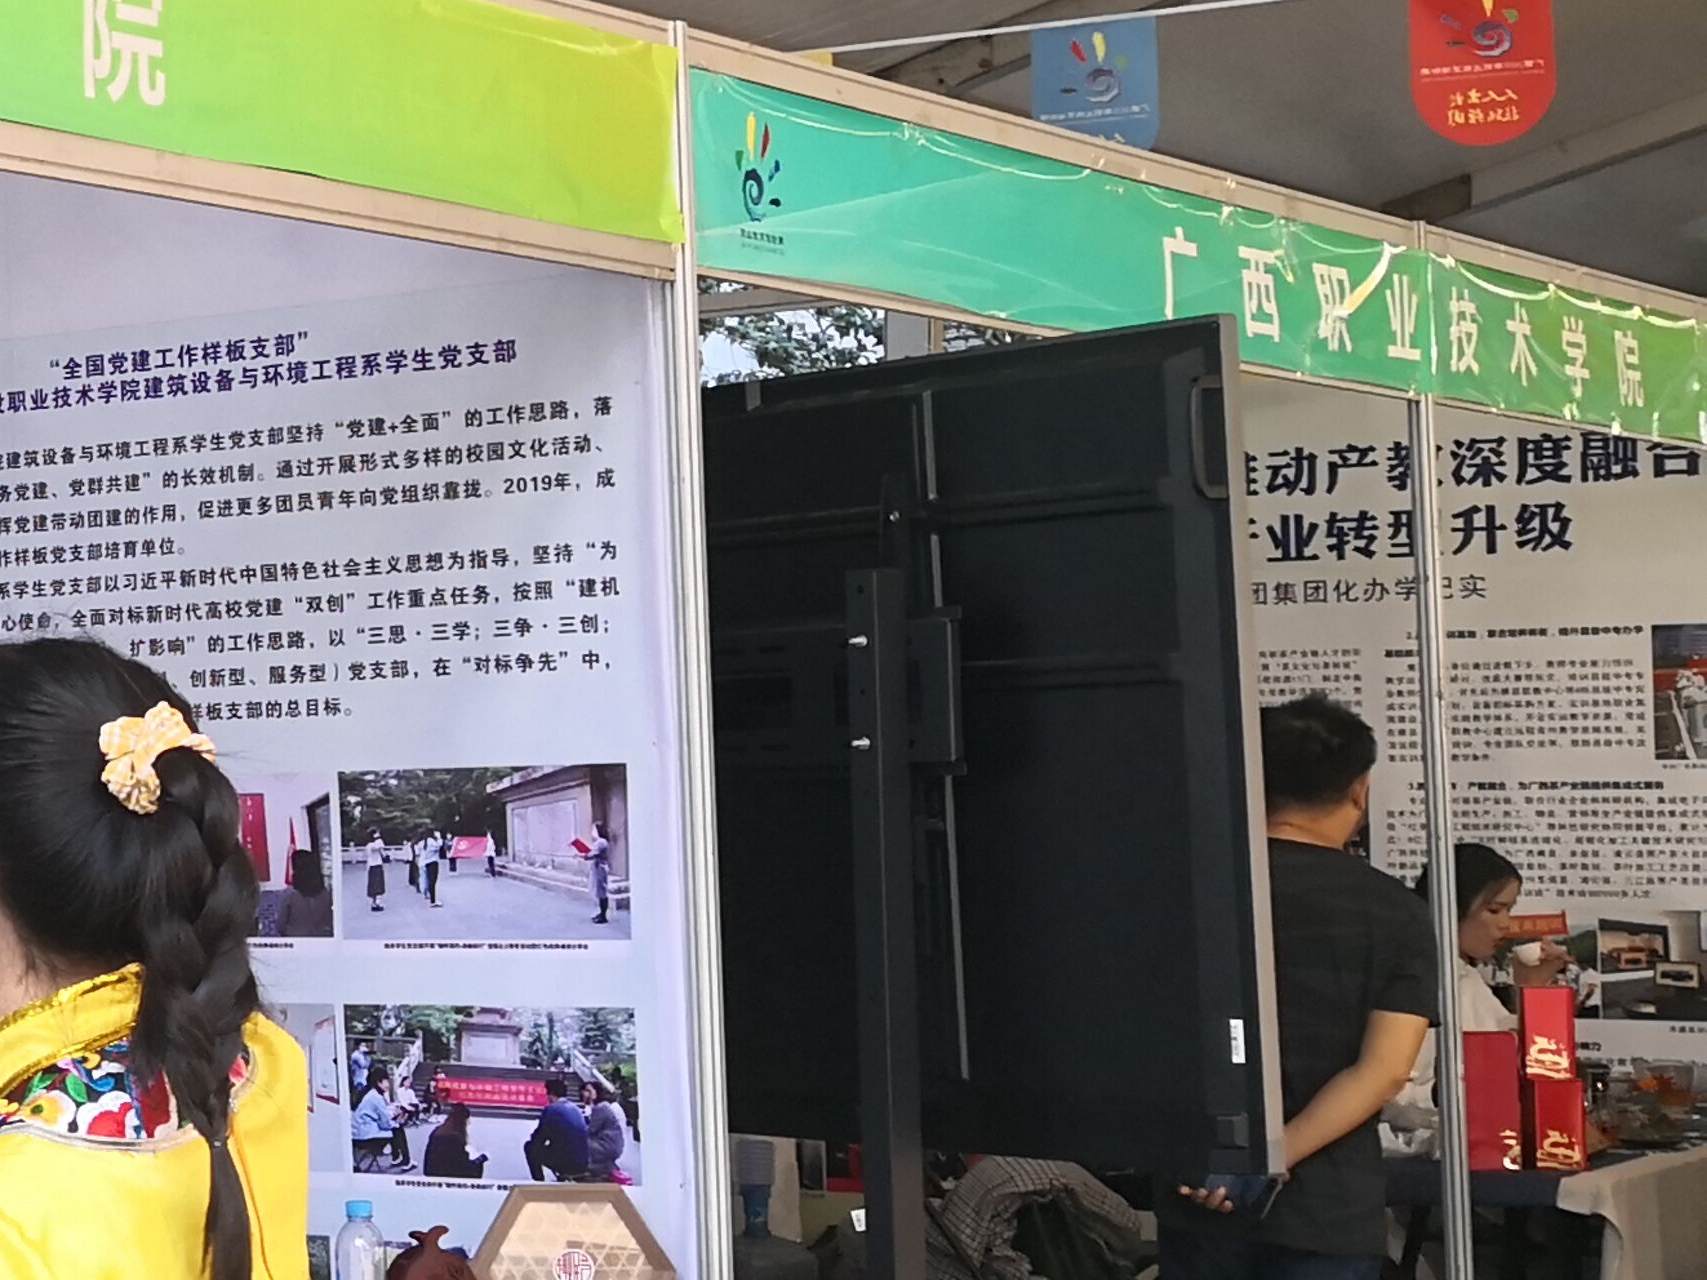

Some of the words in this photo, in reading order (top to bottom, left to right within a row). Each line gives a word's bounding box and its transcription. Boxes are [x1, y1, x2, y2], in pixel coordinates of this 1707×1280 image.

[49, 330, 311, 380] “全国党建工作样板支部”
[1161, 225, 1647, 409] 广西职业技术学院
